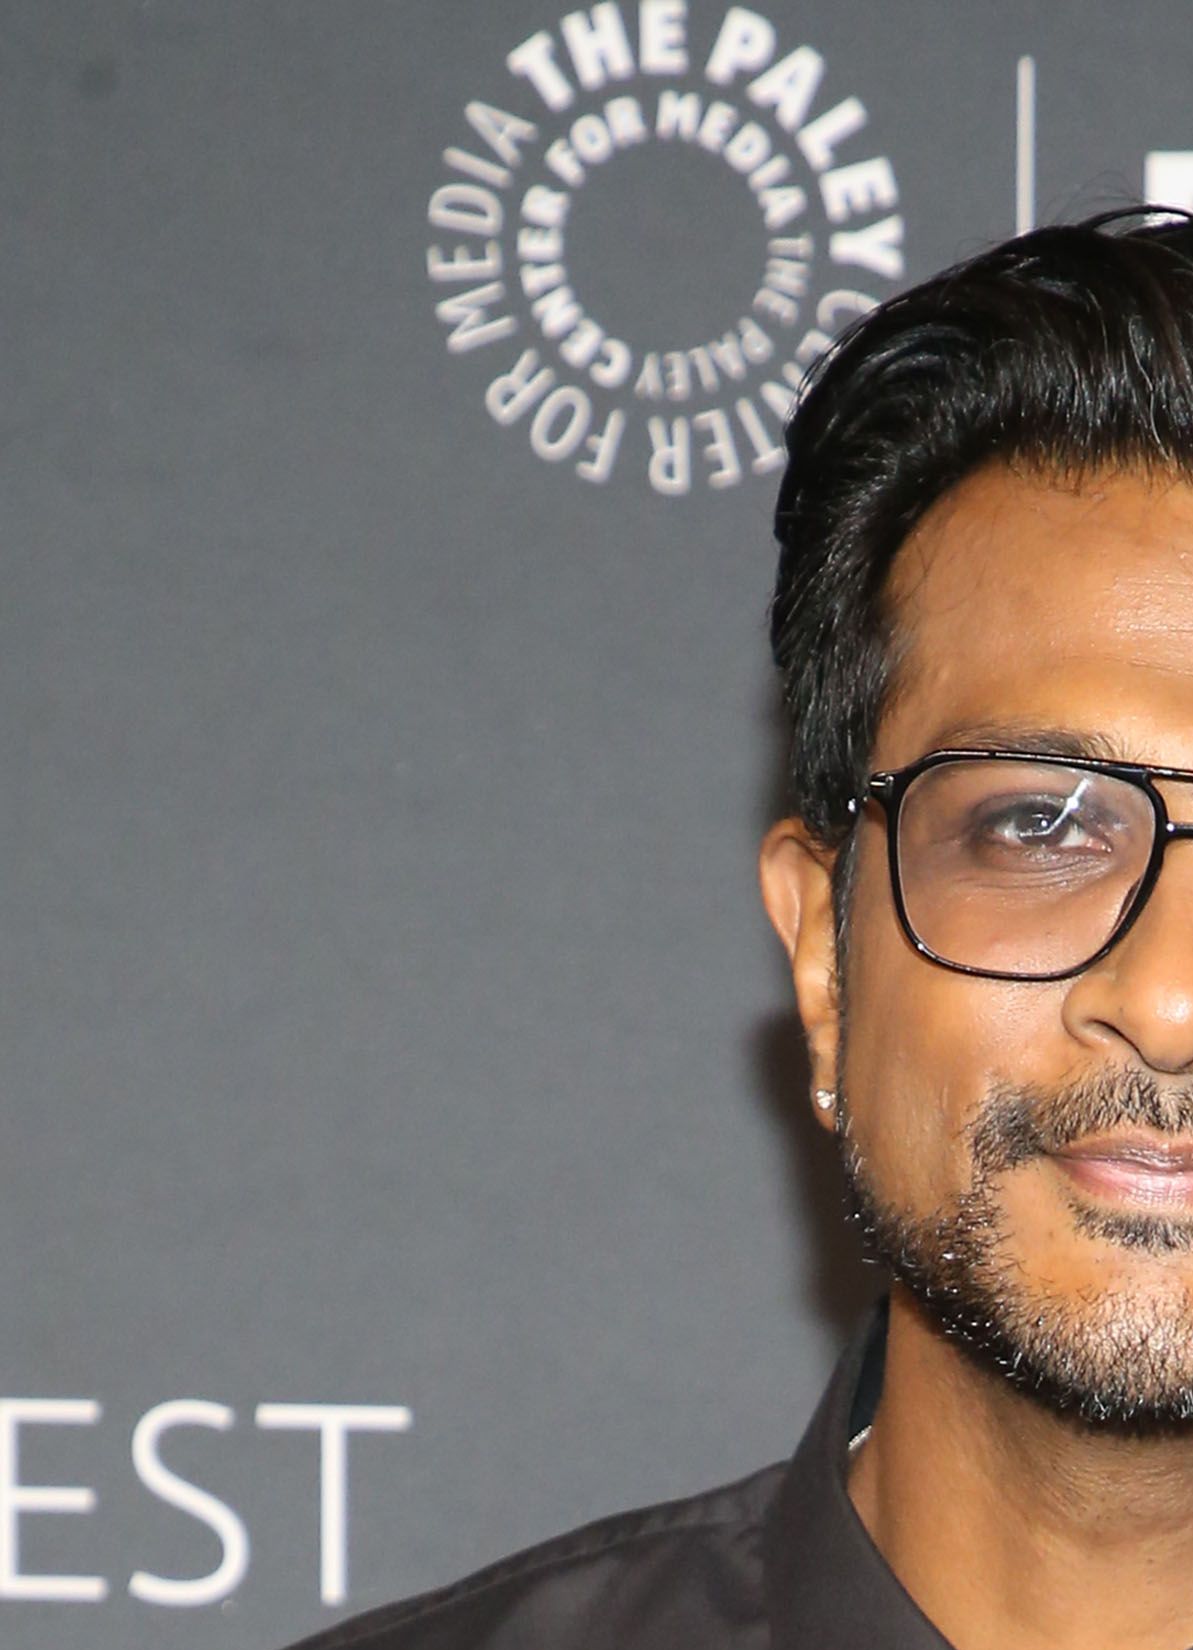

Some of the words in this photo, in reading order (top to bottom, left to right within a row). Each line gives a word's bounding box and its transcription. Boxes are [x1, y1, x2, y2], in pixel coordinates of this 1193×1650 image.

[506, 0, 690, 112] THE
[544, 96, 648, 187] FOR
[655, 90, 807, 231] MEDIA
[705, 5, 905, 281] PALEY
[426, 99, 540, 354] MEDIA
[516, 184, 632, 389] CENTER
[484, 347, 627, 484] FOR
[633, 317, 776, 401] PALEY
[0, 1397, 413, 1607] EST
